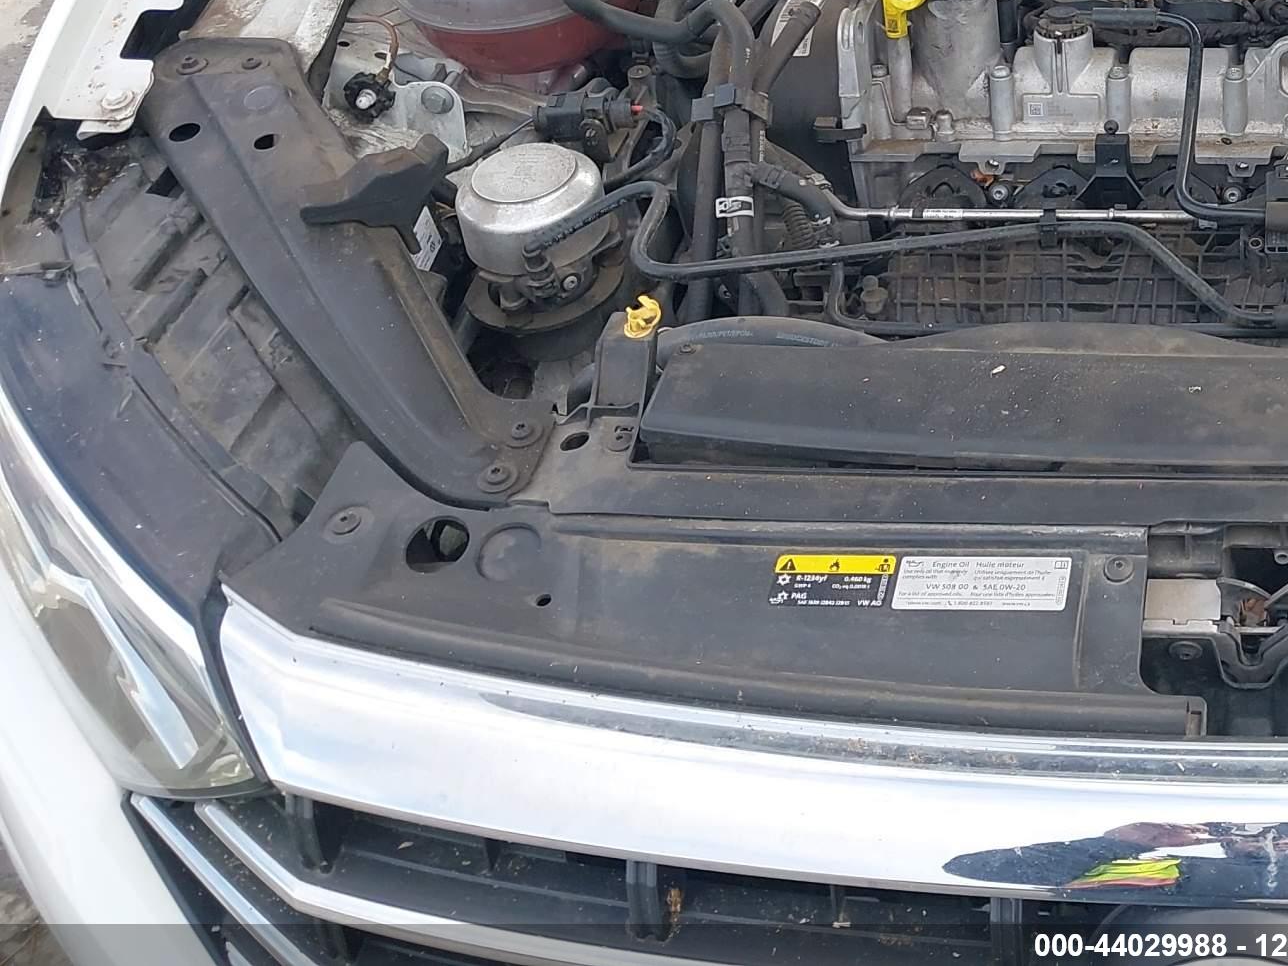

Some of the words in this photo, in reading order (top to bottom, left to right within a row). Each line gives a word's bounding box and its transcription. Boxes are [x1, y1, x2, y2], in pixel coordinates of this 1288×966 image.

[932, 561, 958, 569] Engine
[795, 574, 828, 584] R-1234yf
[999, 583, 1026, 591] 0W-20
[790, 592, 807, 600] PAG
[857, 599, 870, 607] VW
[870, 599, 882, 607] AG
